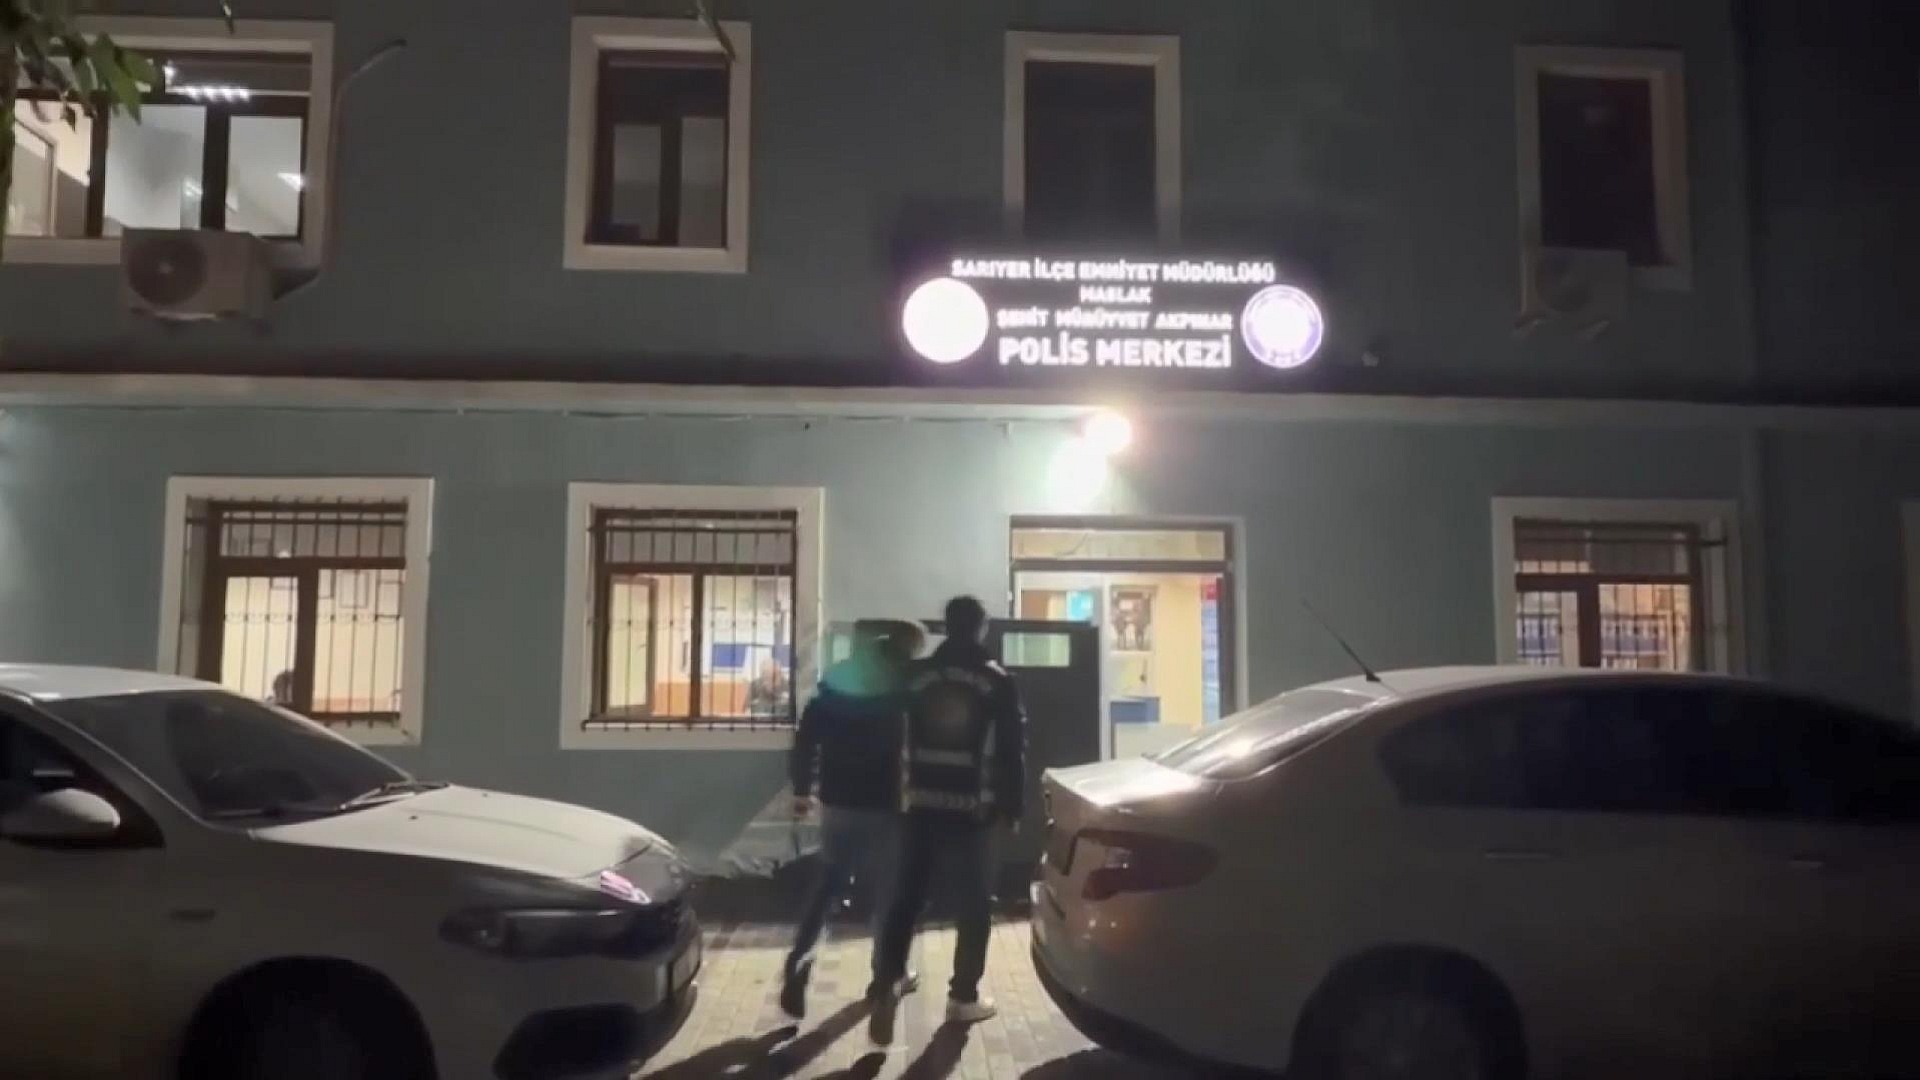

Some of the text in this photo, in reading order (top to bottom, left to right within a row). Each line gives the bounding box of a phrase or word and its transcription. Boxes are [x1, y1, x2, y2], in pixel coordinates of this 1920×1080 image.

[951, 257, 1275, 283] SARIYER İLÇE EMNİYET MÜDÜRLÜĞÜ
[1080, 286, 1152, 303] MASLAK
[1000, 331, 1089, 365] POLİS
[1096, 334, 1232, 367] MERKEZİ
